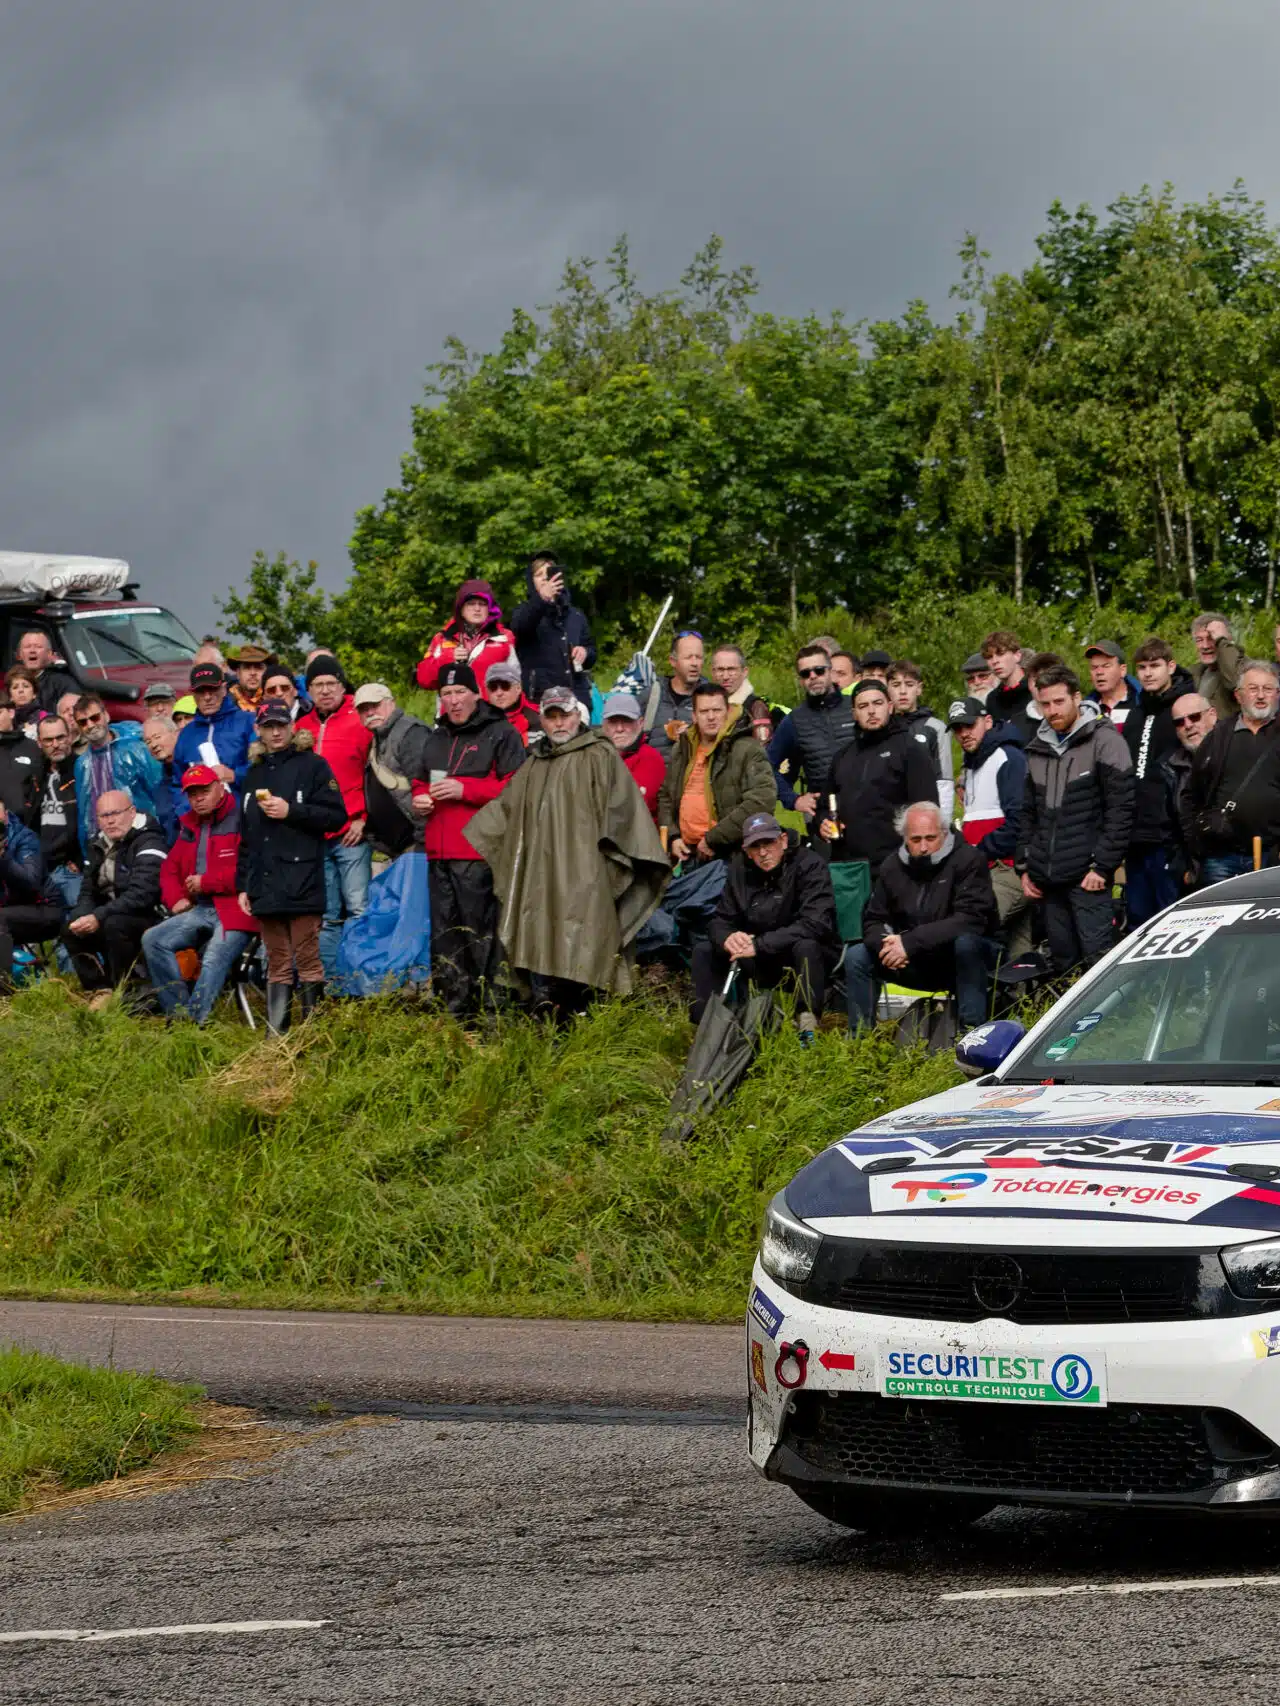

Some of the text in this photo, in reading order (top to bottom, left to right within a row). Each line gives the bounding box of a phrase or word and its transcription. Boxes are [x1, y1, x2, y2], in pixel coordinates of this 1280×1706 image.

[1136, 714, 1156, 779] JACK&JONES
[1131, 930, 1206, 960] EL6
[931, 1137, 1177, 1163] FFSA
[992, 1178, 1202, 1204] TotalEnergies
[753, 1298, 777, 1328] MICHELIN
[888, 1352, 1045, 1380] SECURITEST
[888, 1381, 1046, 1398] CONTROLE TECHNIQUE
